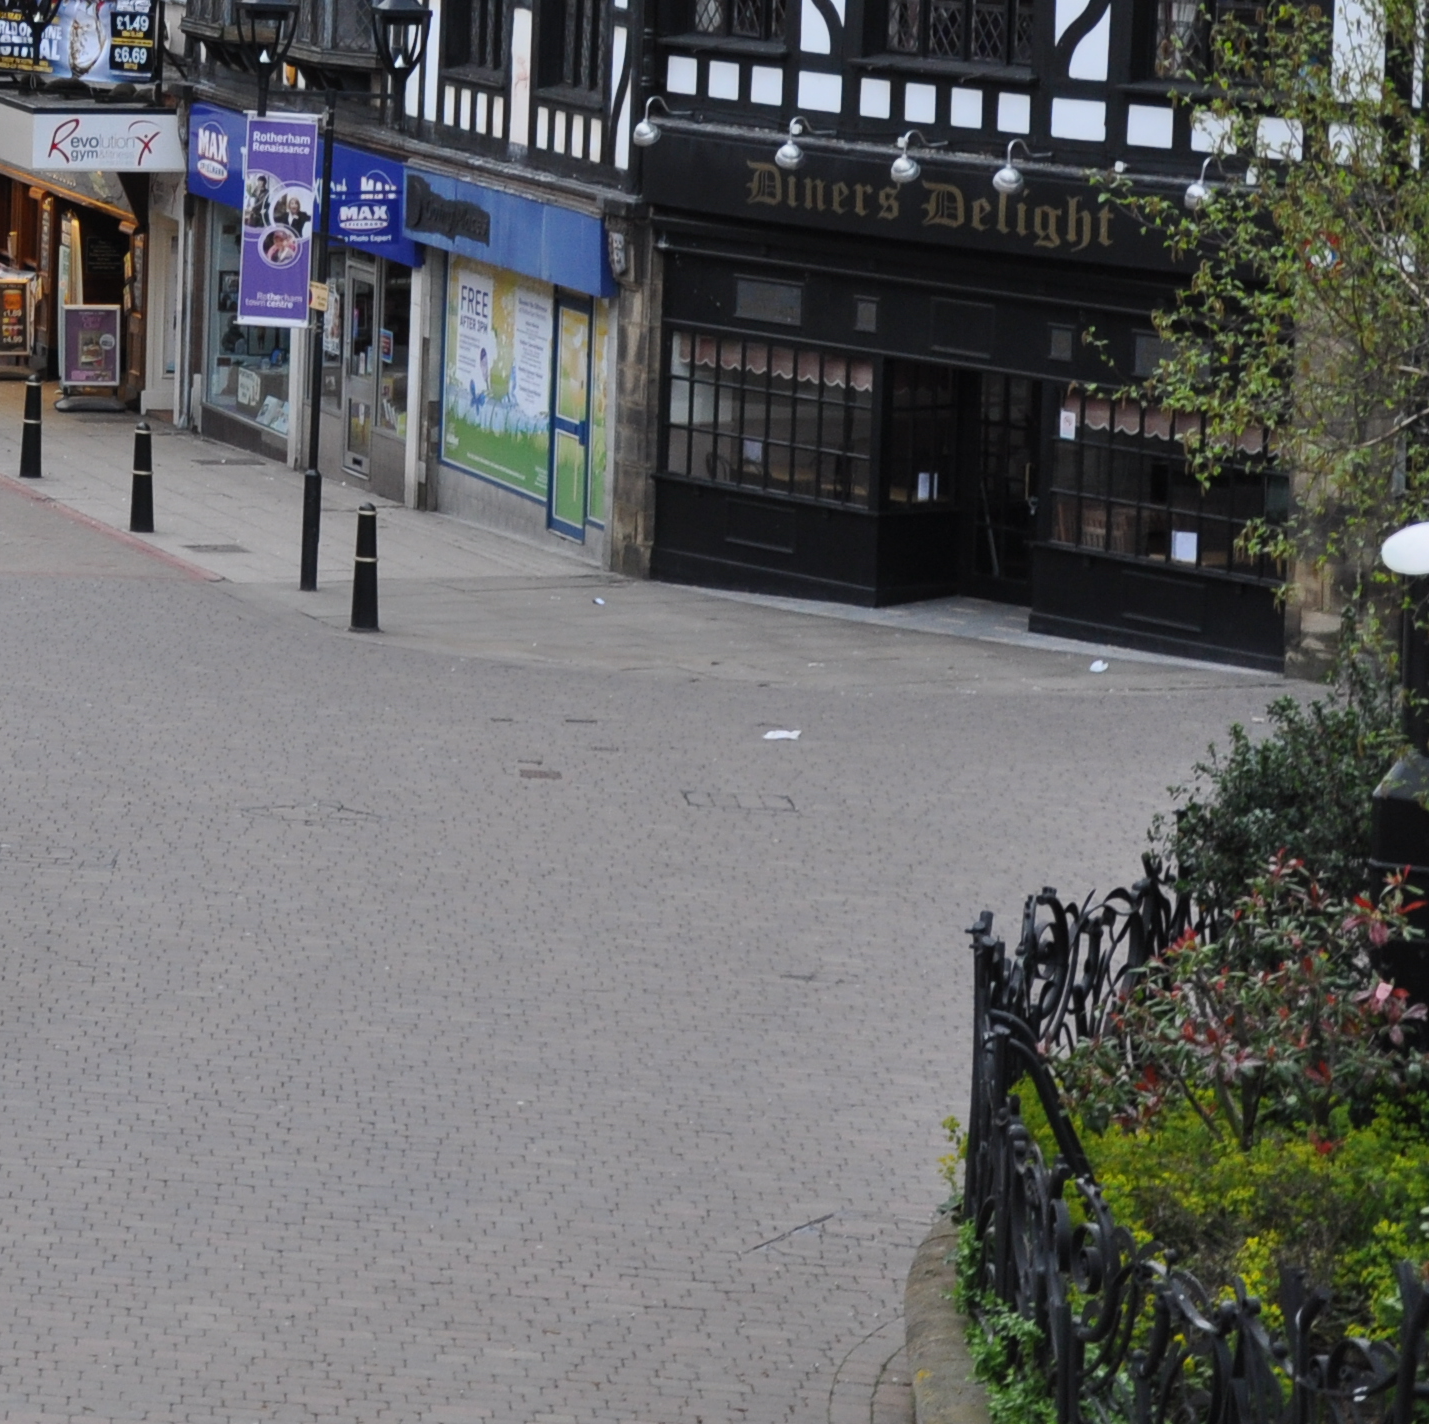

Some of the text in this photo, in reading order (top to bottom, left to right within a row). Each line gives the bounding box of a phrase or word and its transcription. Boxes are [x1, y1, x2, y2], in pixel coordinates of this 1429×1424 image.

[116, 15, 150, 31] £1.49
[114, 47, 148, 63] £6.69
[48, 118, 135, 164] Revolution
[198, 127, 228, 163] MAX
[253, 131, 311, 145] Rotherham
[70, 149, 99, 162] gym
[253, 142, 310, 155] Renaissance
[340, 205, 388, 220] MAX
[746, 160, 1114, 253] Diners Delight
[349, 234, 370, 242] Photo
[370, 235, 391, 243] Expert
[257, 291, 303, 303] Rotherham
[266, 299, 294, 309] centre
[461, 285, 489, 318] FREE
[460, 315, 476, 331] AFTER
